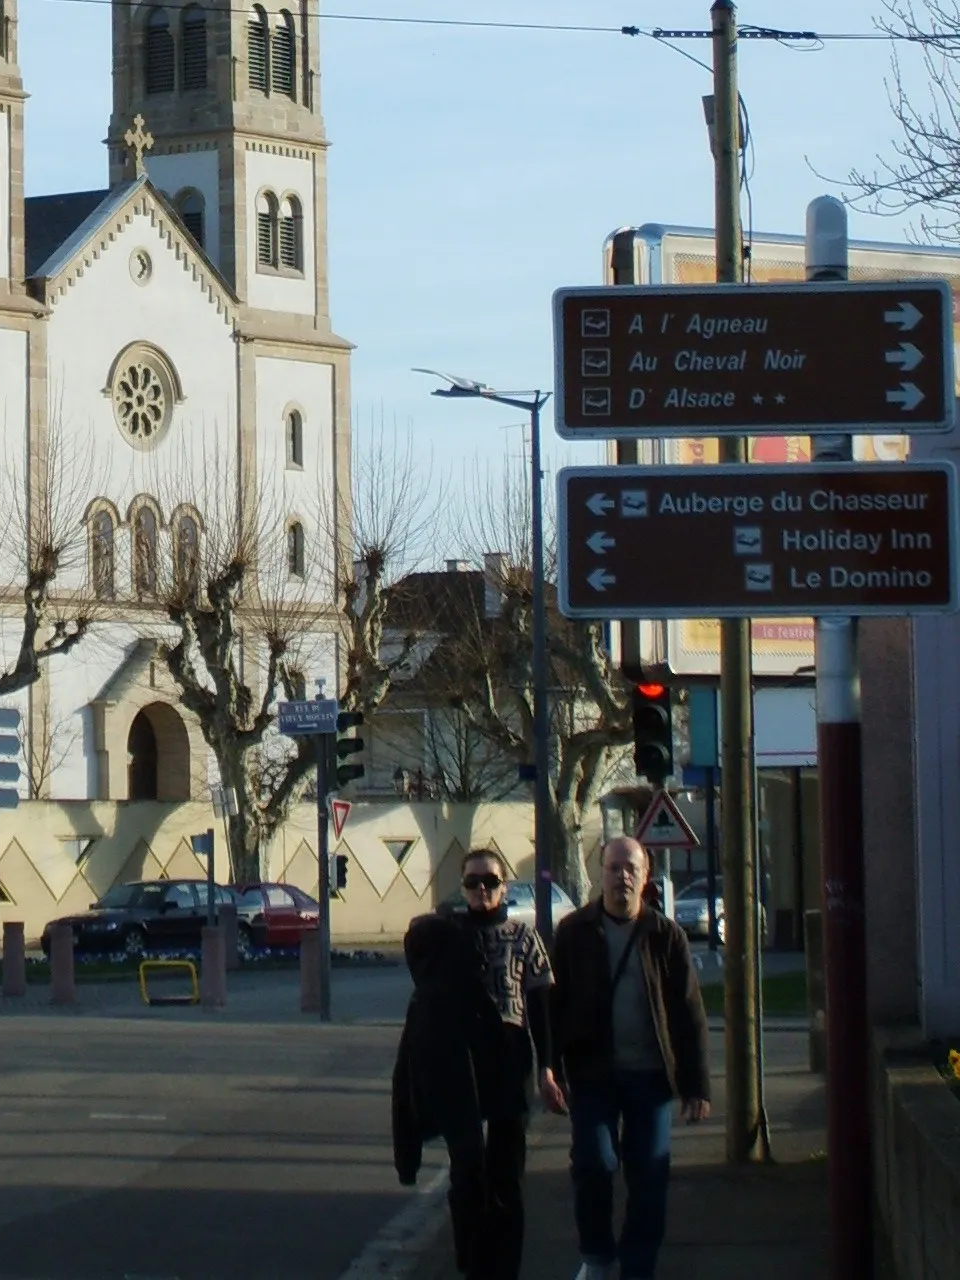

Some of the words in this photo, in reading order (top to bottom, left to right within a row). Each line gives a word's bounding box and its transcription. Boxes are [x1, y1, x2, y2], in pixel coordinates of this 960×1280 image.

[628, 315, 644, 334] A
[686, 313, 769, 340] Agneau
[628, 353, 658, 372] Au
[674, 350, 746, 371] Cheval
[764, 349, 806, 370] Noir
[664, 387, 736, 409] Alsace
[659, 492, 763, 516] Auberge
[772, 490, 803, 511] du
[809, 489, 928, 511] Chasseur
[782, 528, 880, 553] Holiday
[891, 527, 932, 548] Inn
[791, 567, 821, 588] Le
[830, 565, 932, 587] Domino
[777, 626, 815, 639] festiva
